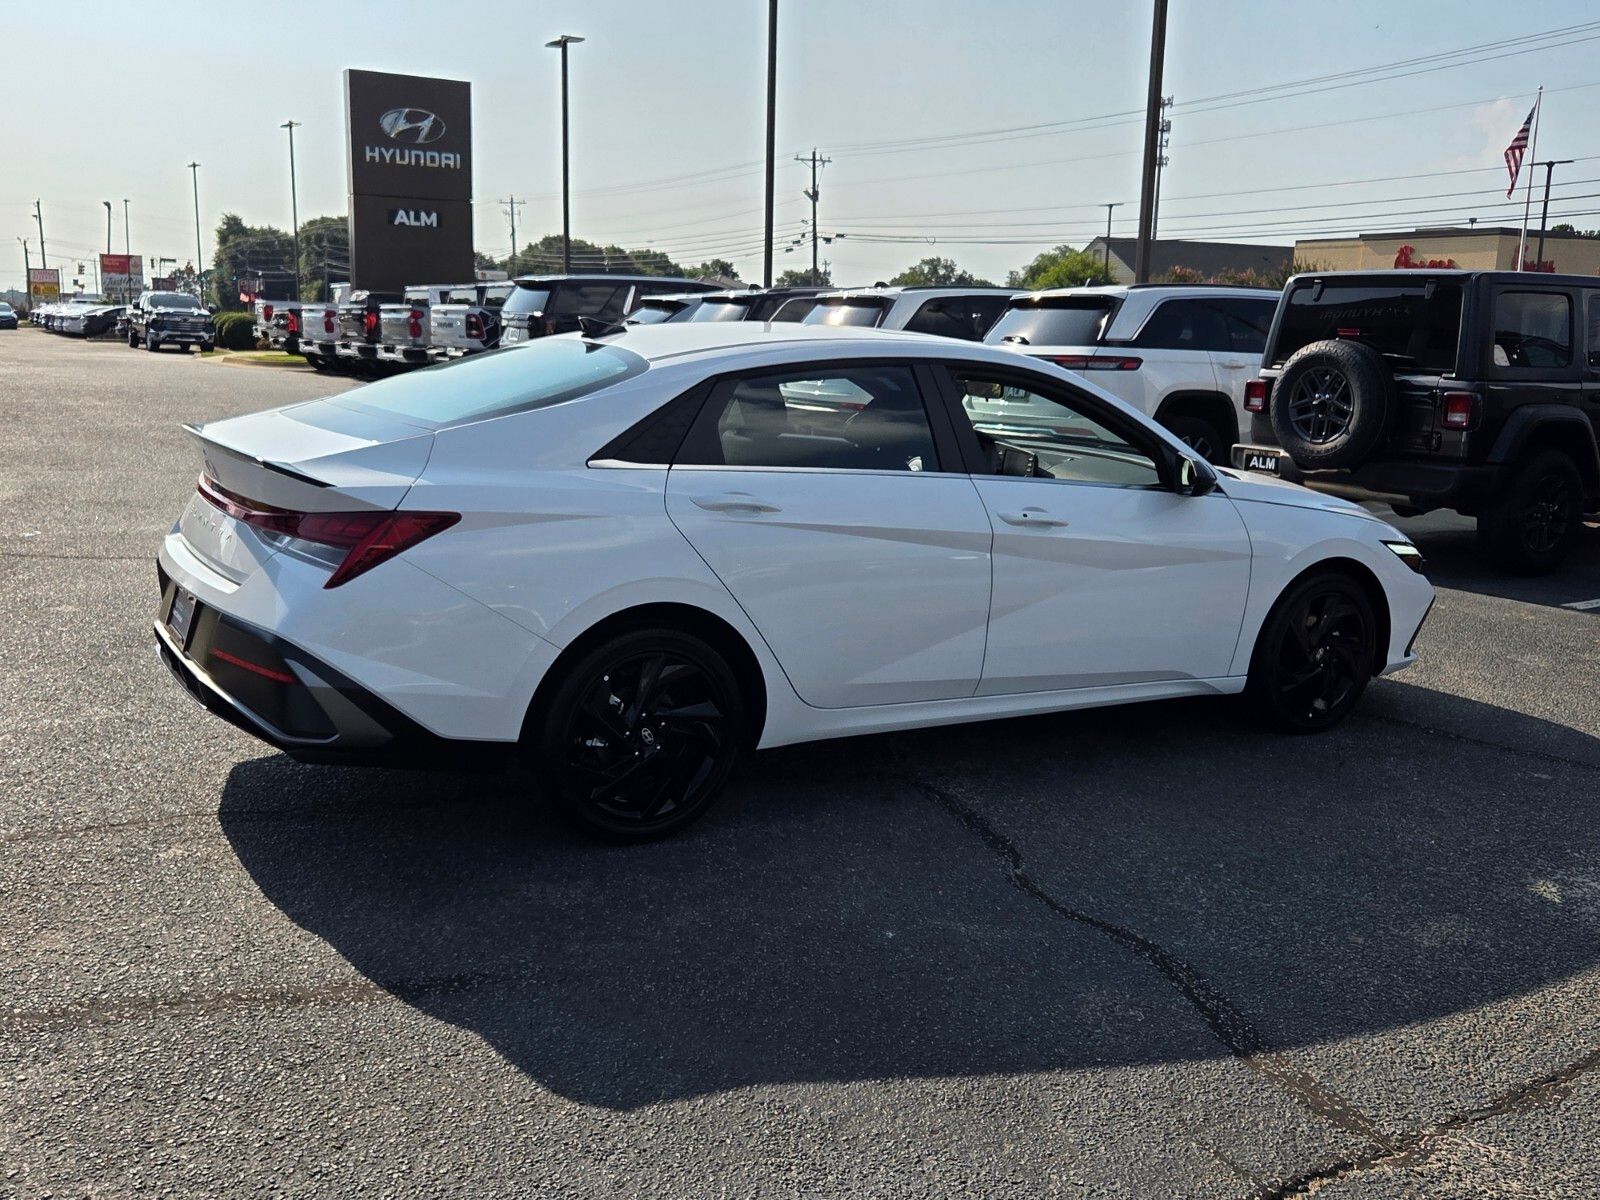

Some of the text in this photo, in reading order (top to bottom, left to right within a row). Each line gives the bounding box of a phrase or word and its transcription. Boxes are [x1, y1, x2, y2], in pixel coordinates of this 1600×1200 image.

[365, 146, 461, 169] HYUNDAI
[394, 209, 438, 227] ALM
[1249, 456, 1276, 470] ALM
